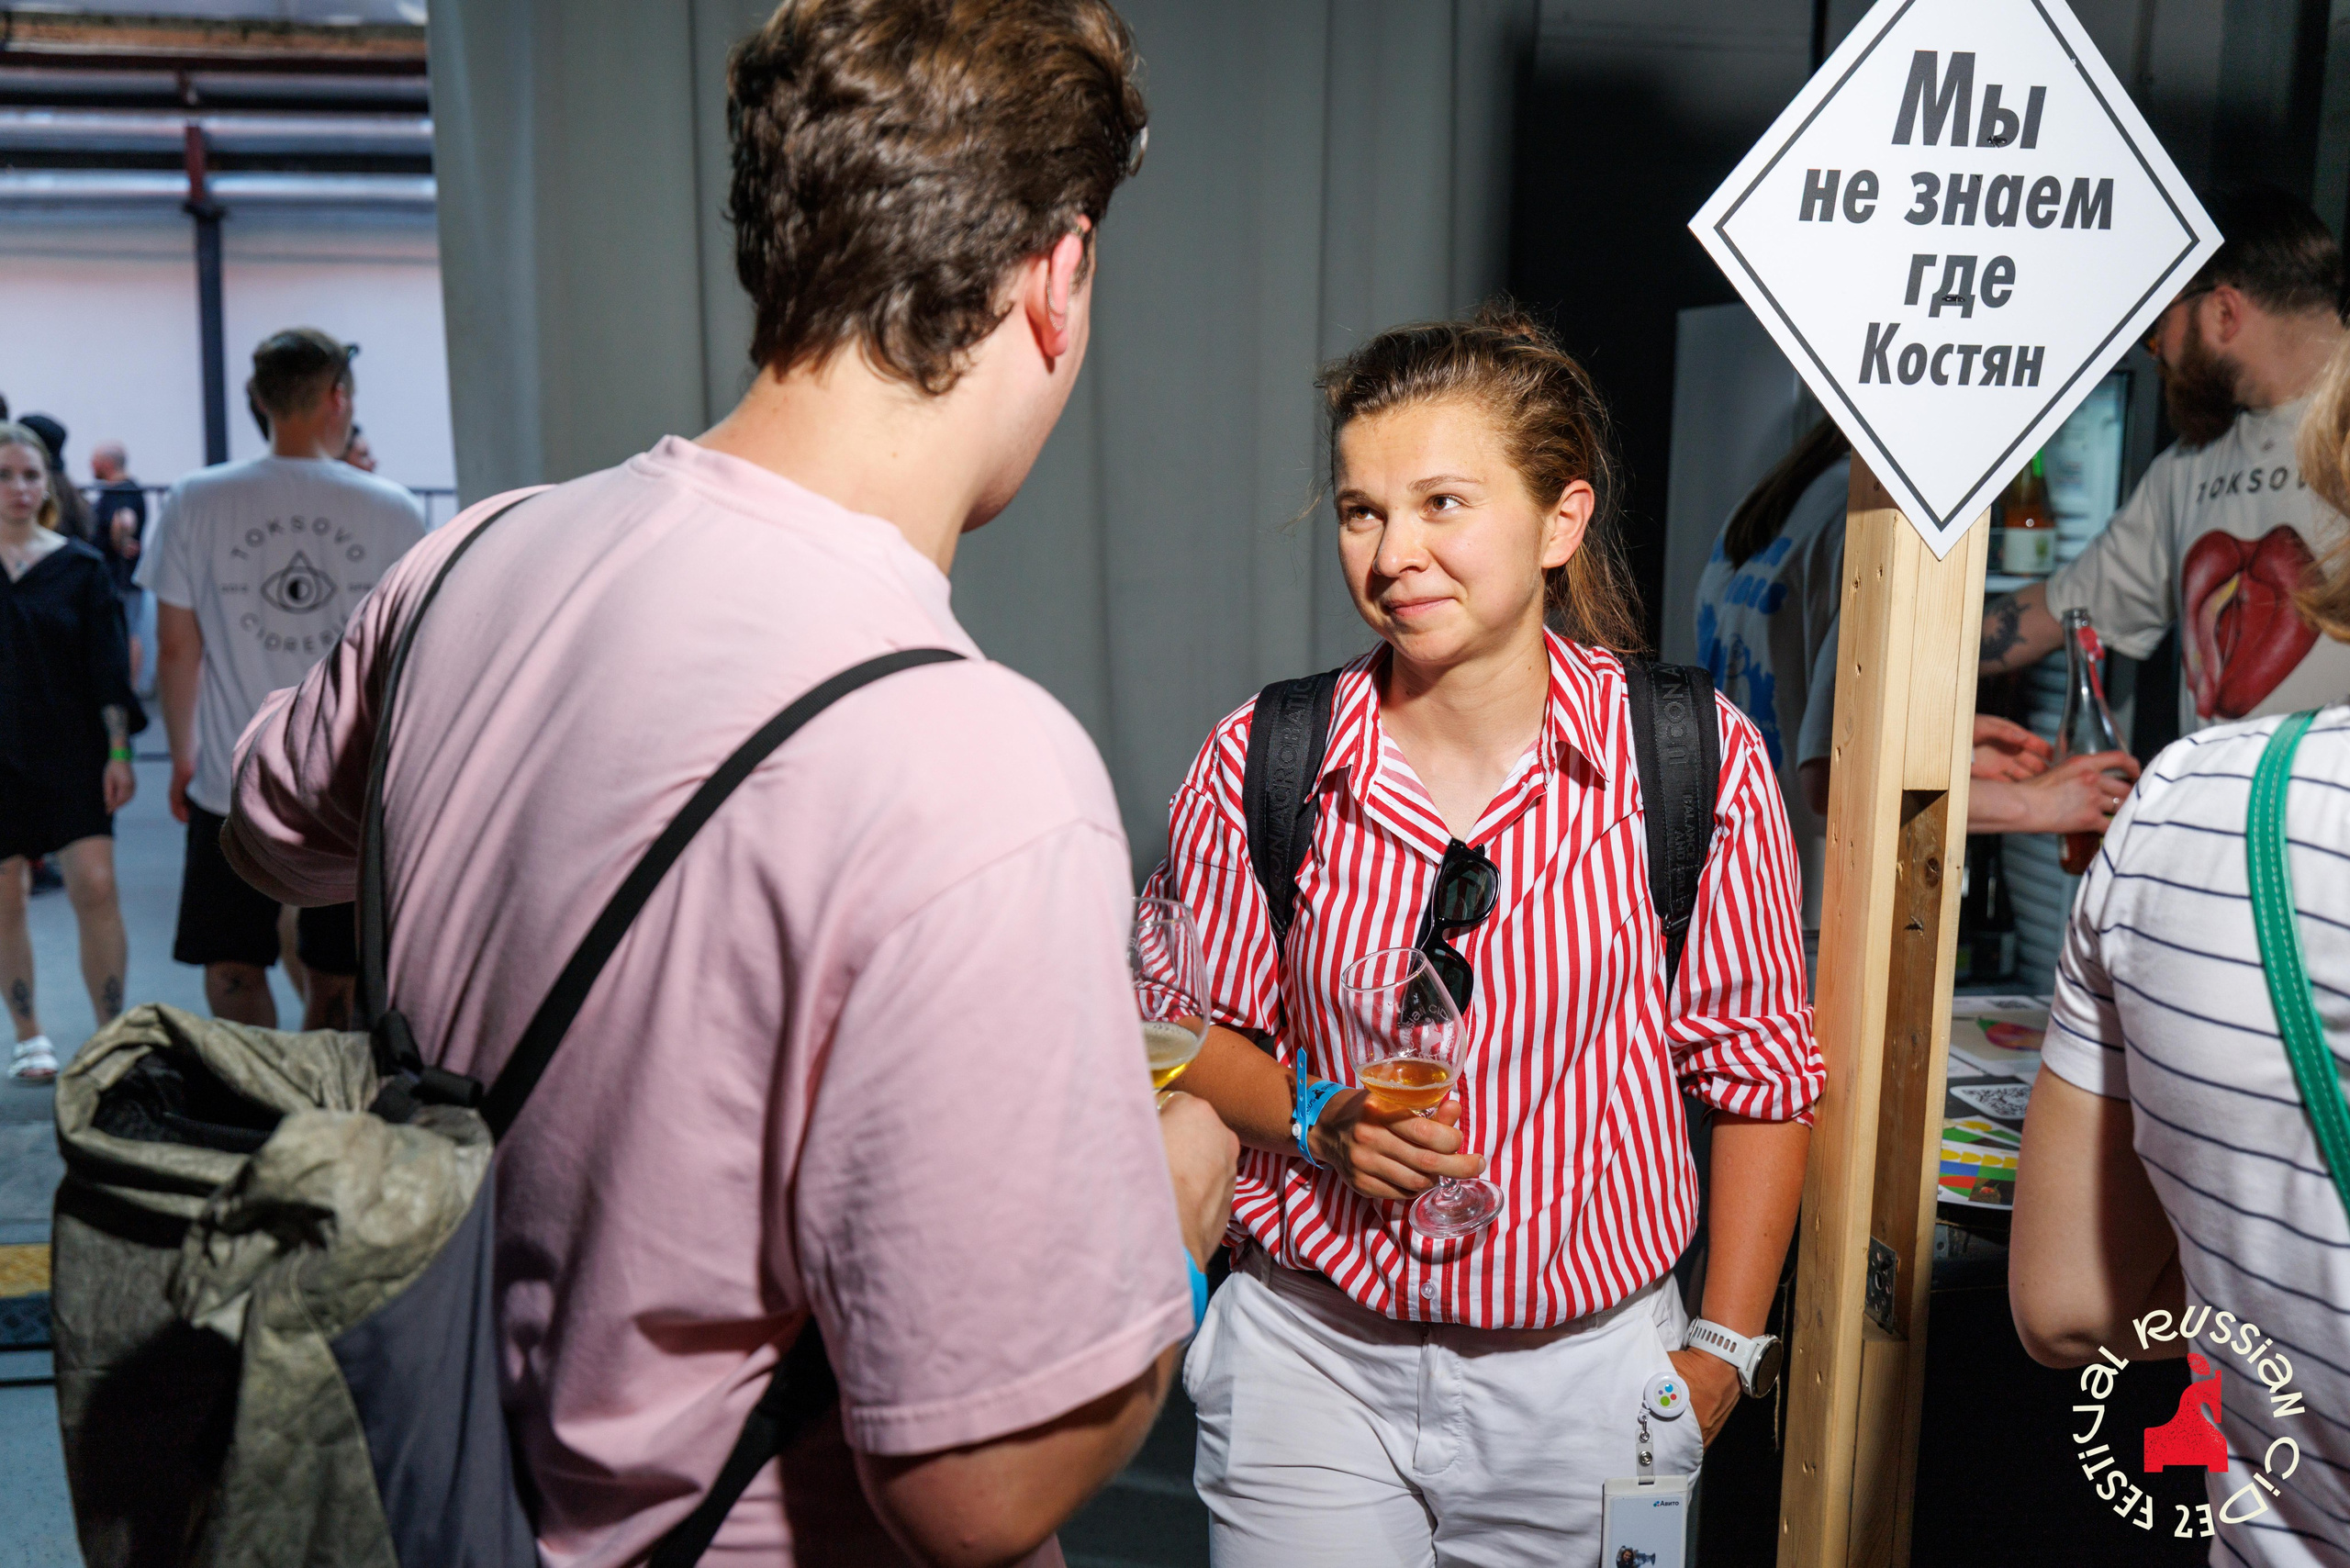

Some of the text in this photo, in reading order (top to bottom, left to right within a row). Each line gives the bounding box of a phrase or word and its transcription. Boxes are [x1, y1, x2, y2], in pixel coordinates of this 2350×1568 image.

[1892, 50, 2046, 149] Мы
[1799, 169, 2114, 230] не знаем
[1904, 254, 2016, 319] где
[1859, 322, 2045, 387] Костян
[231, 515, 365, 563] TOKSOVO
[1269, 677, 1315, 830] ACROBATIC
